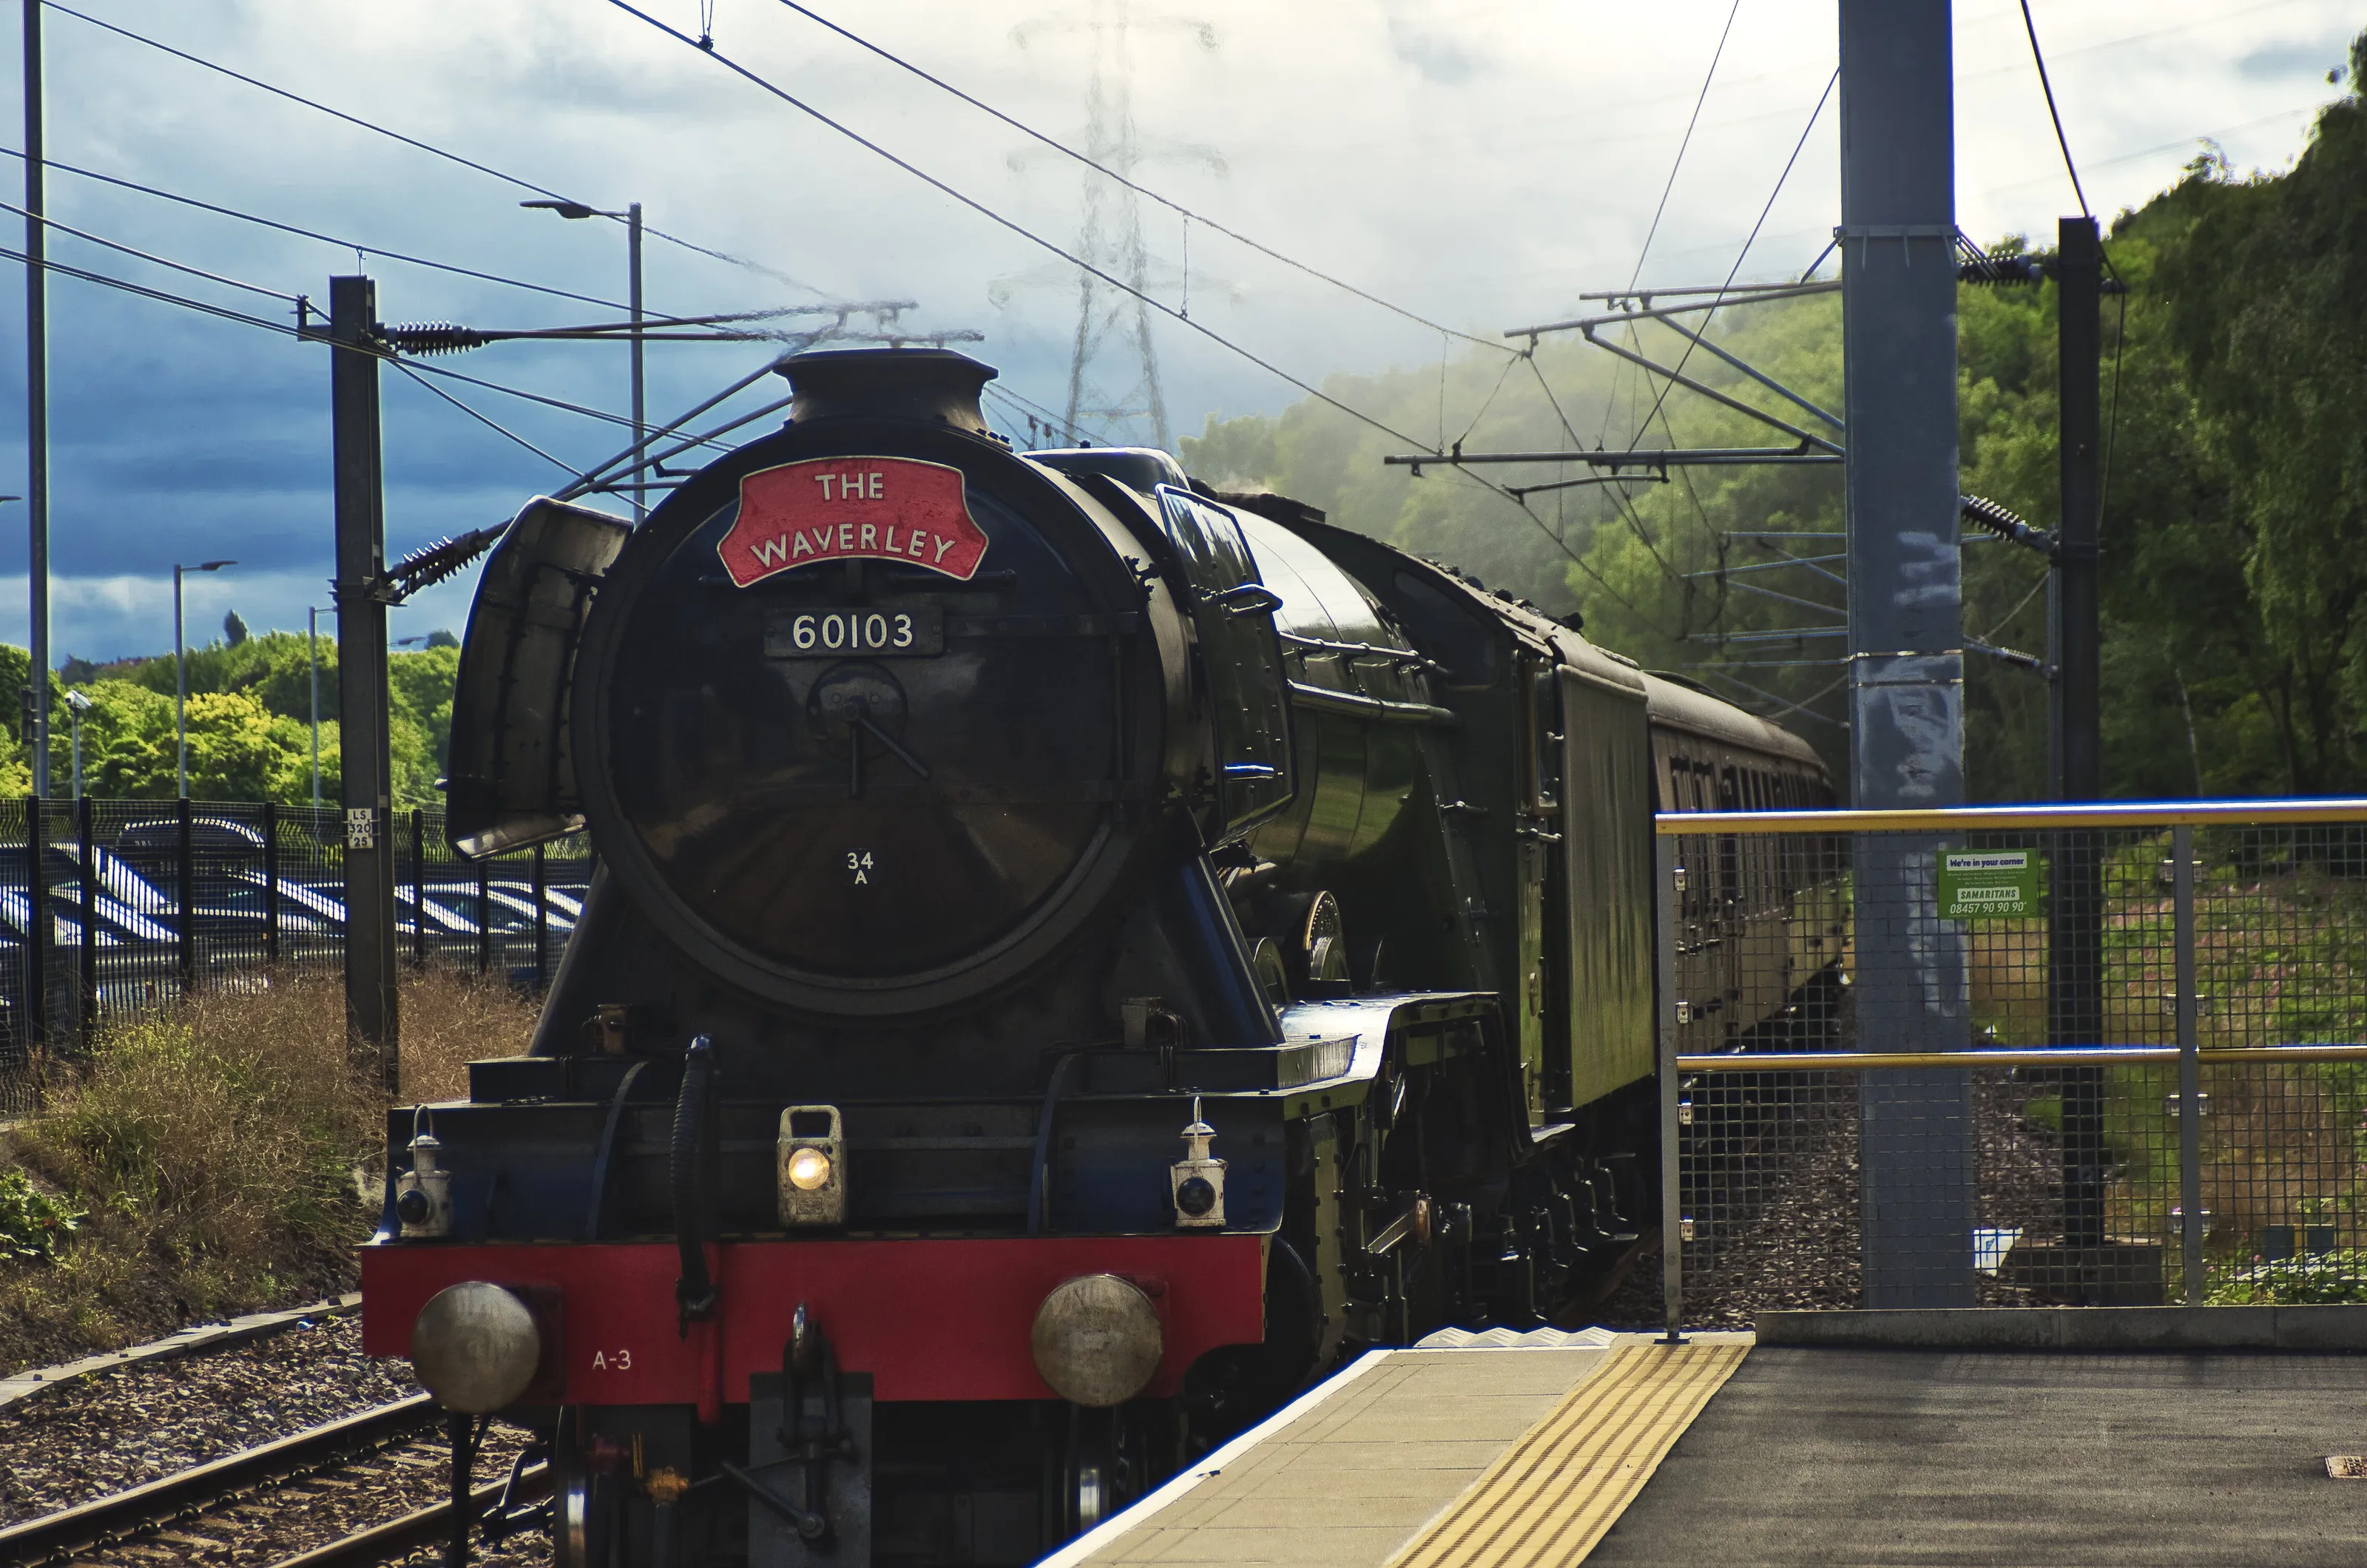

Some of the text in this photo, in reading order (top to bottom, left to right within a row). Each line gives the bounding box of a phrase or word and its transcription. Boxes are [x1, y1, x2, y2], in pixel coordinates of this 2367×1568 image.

[814, 472, 884, 501] THE
[749, 523, 956, 569] WAVERLEY
[792, 613, 914, 649] 60103
[353, 810, 366, 820] LS
[349, 823, 371, 834] 320
[354, 837, 368, 847] 25
[847, 851, 874, 870] 34
[1950, 858, 2025, 868] We're in your corner
[854, 869, 868, 885] A
[1960, 889, 2016, 899] SAMARITANS
[1950, 903, 1980, 914] 08457
[1982, 902, 1995, 913] 90
[1997, 902, 2010, 913] 90
[592, 1349, 631, 1370] A-3
